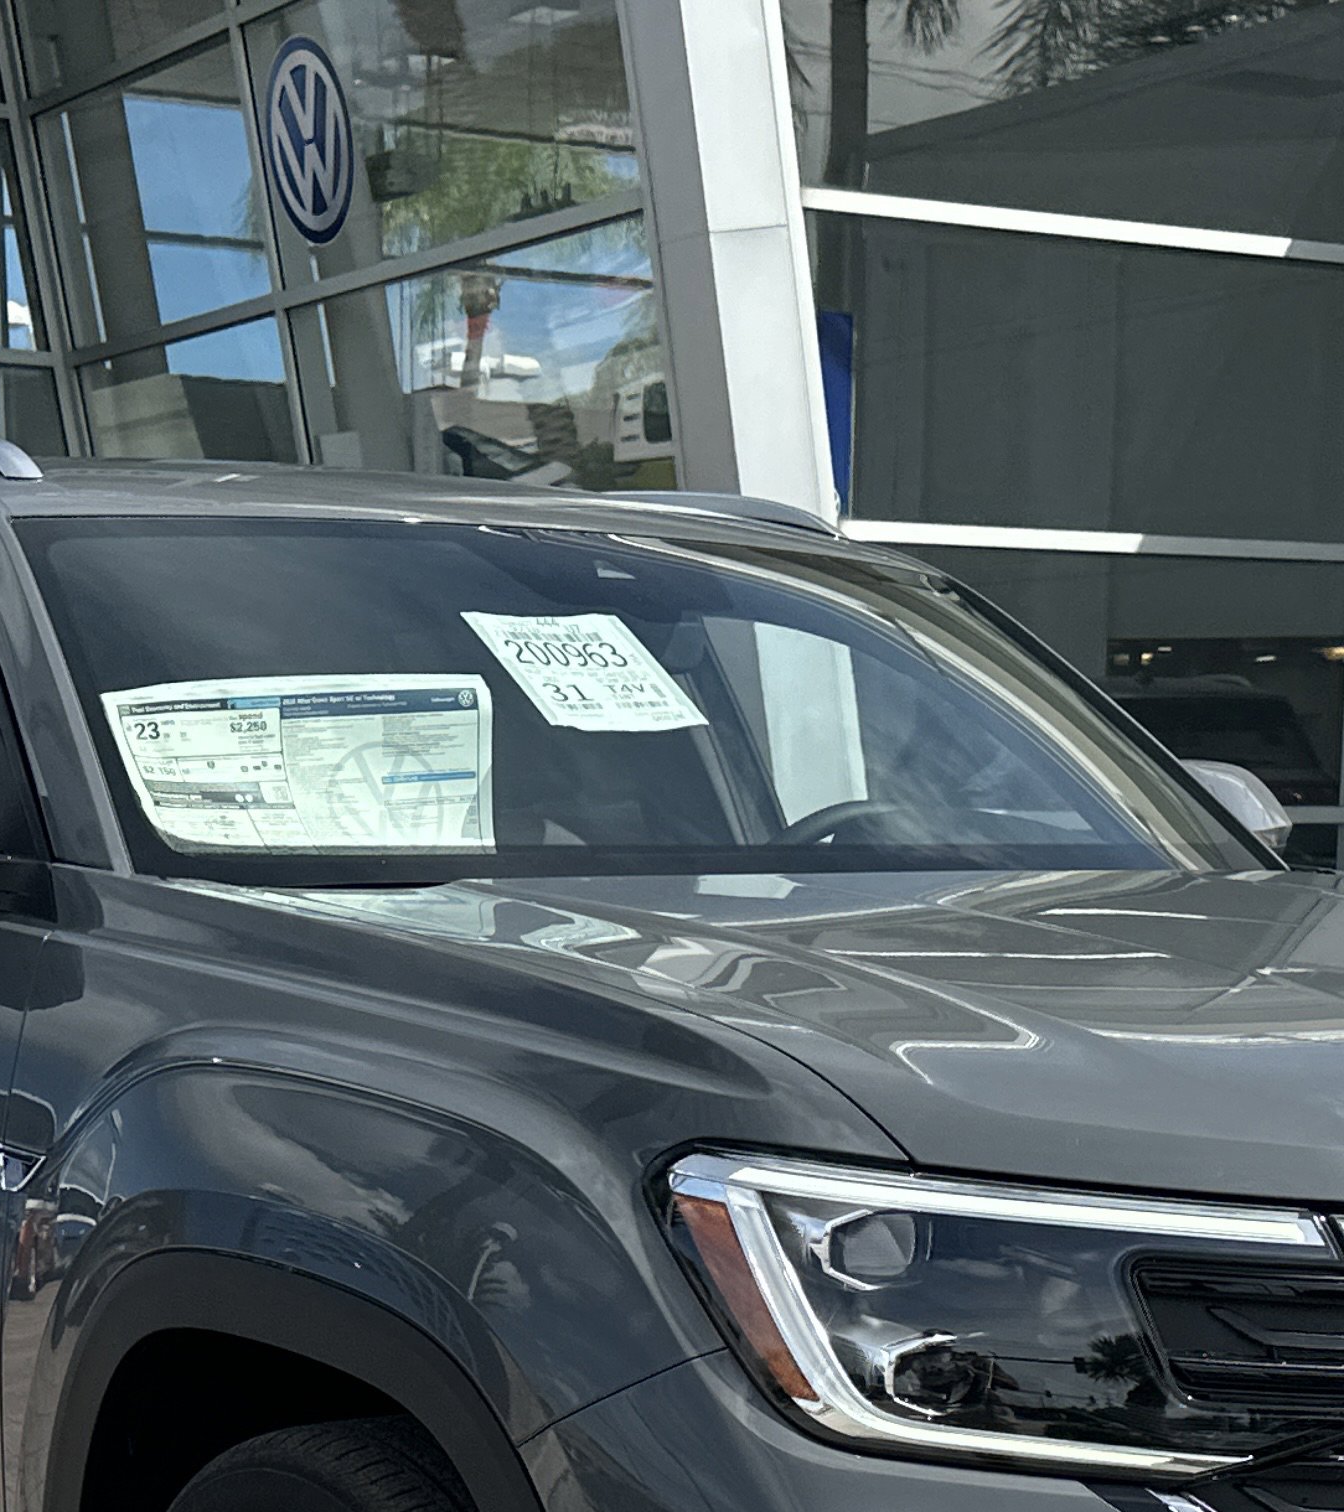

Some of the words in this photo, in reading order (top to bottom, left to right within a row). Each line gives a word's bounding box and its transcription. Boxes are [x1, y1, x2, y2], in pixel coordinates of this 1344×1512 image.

[271, 47, 351, 233] VW
[504, 639, 629, 667] 200963
[542, 683, 595, 702] 31
[133, 721, 161, 740] 23
